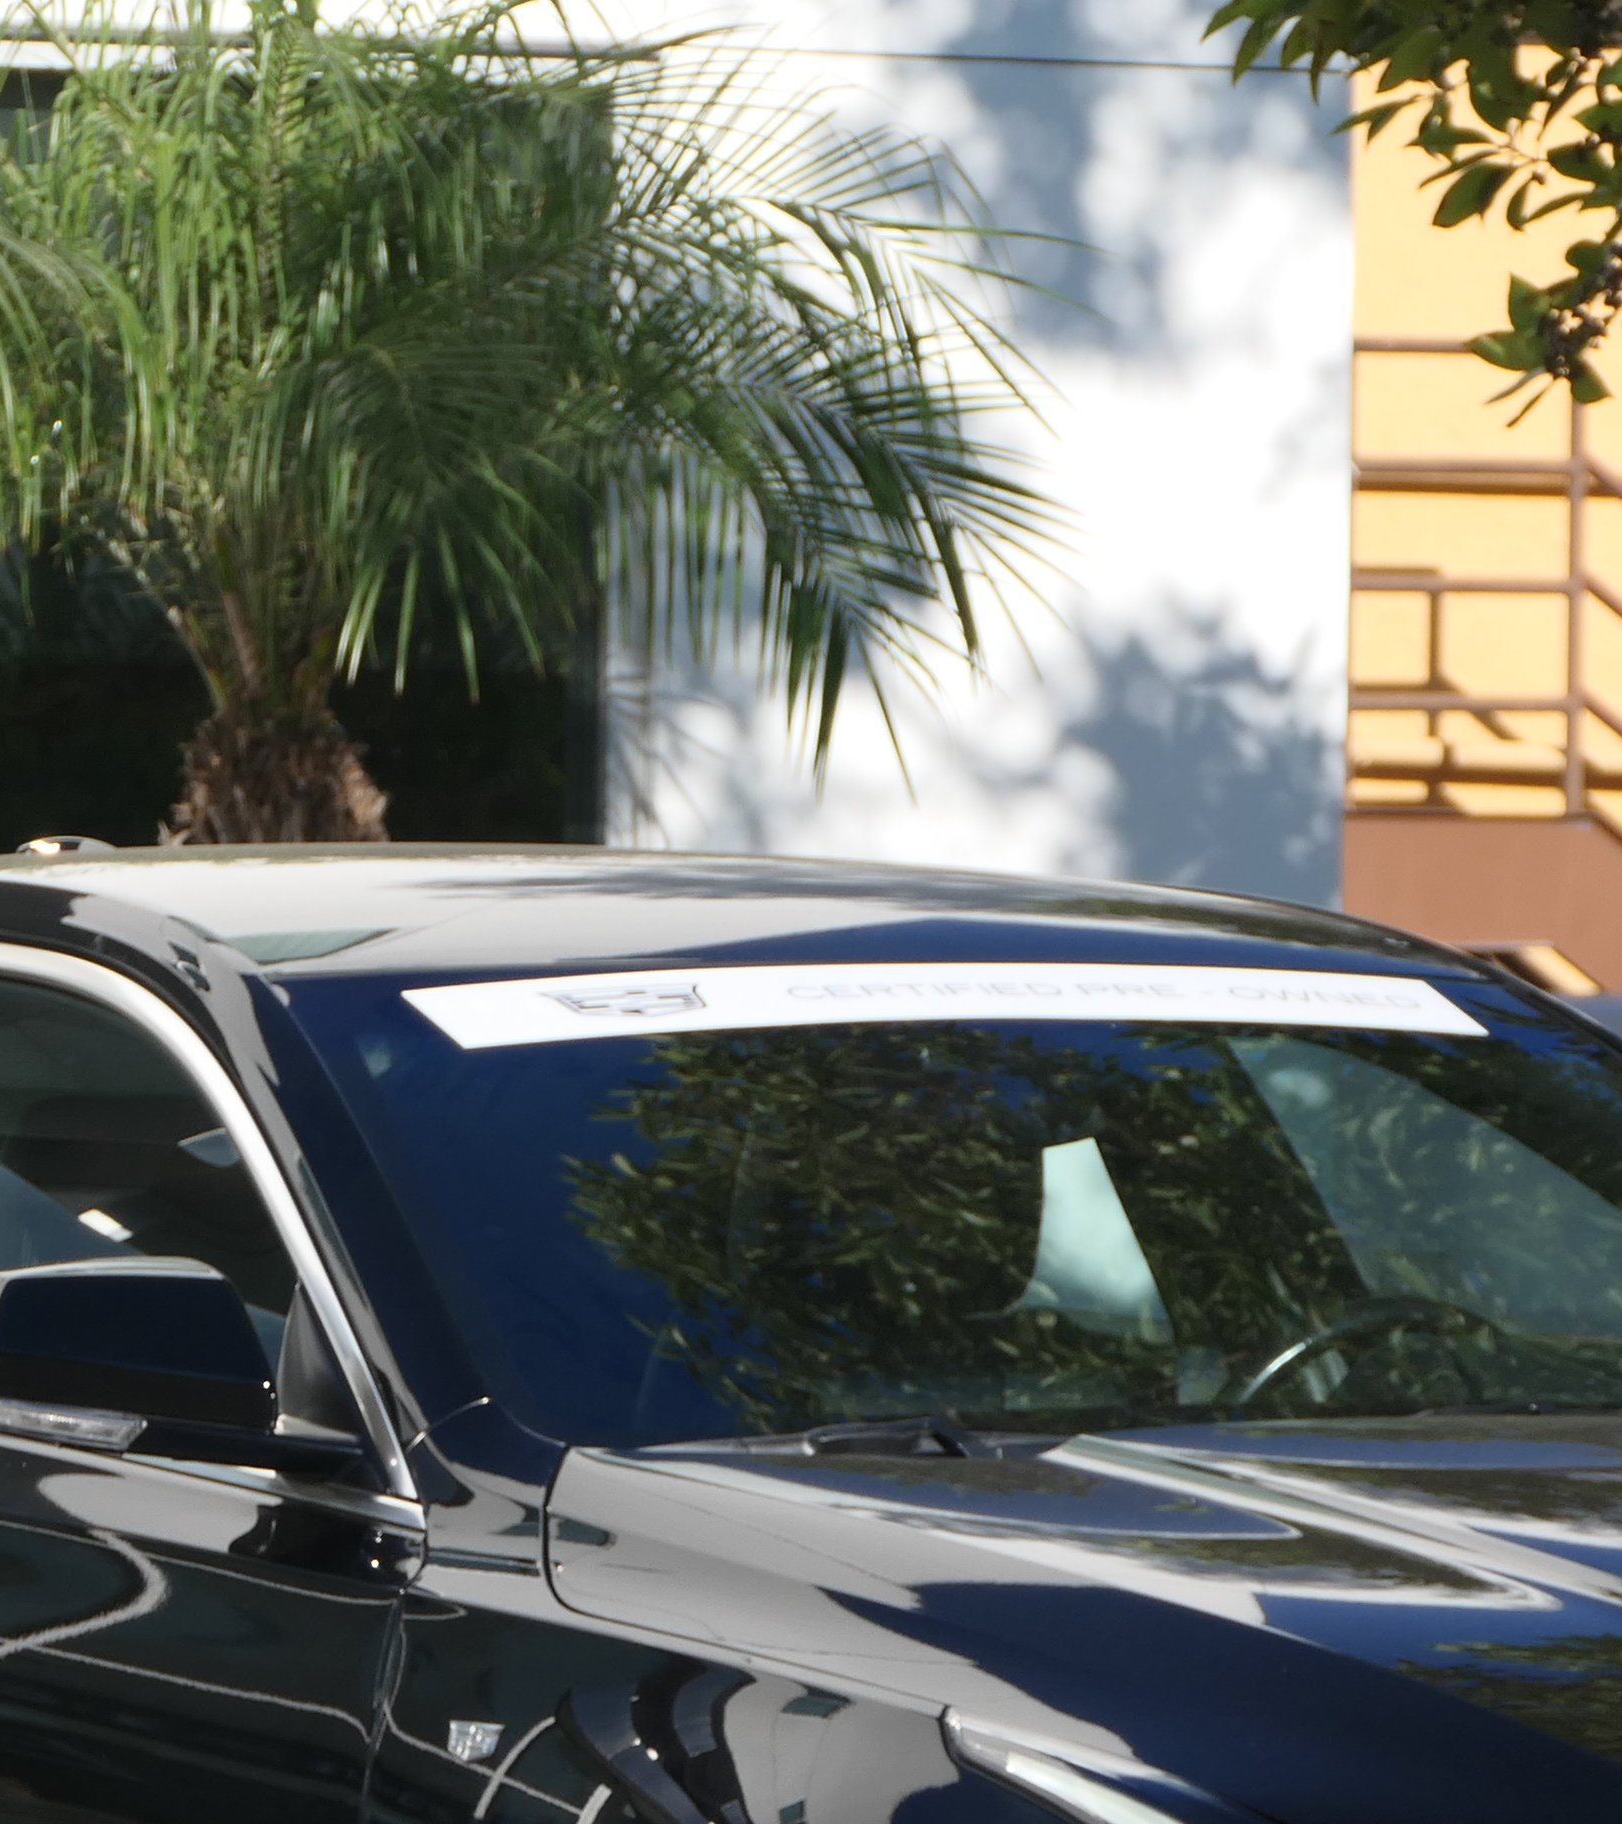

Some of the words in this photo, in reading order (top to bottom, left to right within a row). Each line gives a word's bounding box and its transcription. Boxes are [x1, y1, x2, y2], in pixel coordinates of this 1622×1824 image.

[786, 982, 1063, 999] CERTIFIED
[1076, 983, 1182, 998] PRE
[1228, 986, 1421, 1009] OWNED
